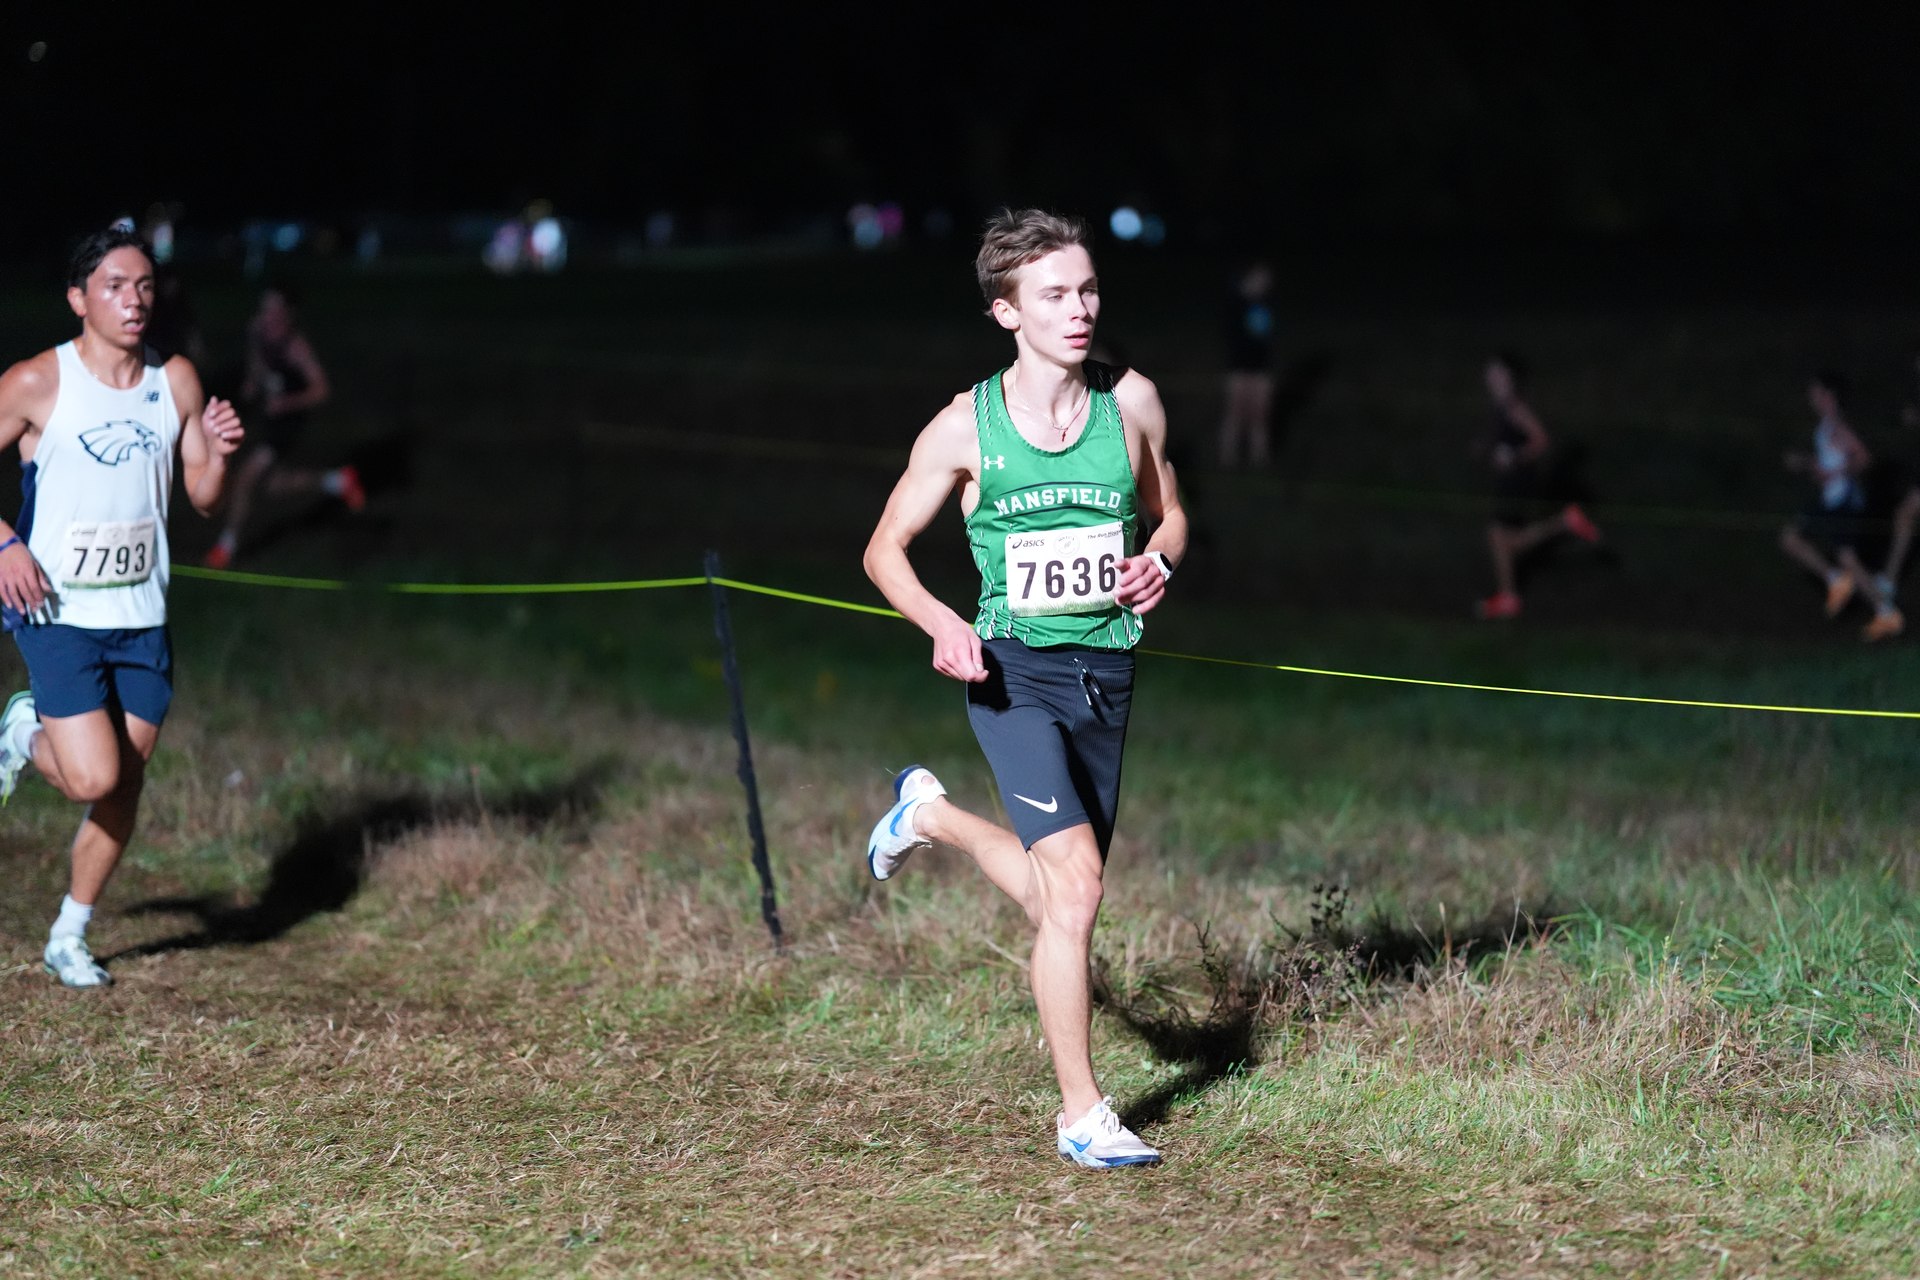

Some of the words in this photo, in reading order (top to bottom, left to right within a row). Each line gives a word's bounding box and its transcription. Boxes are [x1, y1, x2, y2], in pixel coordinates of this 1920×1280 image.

[993, 488, 1121, 516] MANSFIELD
[73, 543, 146, 577] 7793
[1016, 553, 1117, 600] 7636
